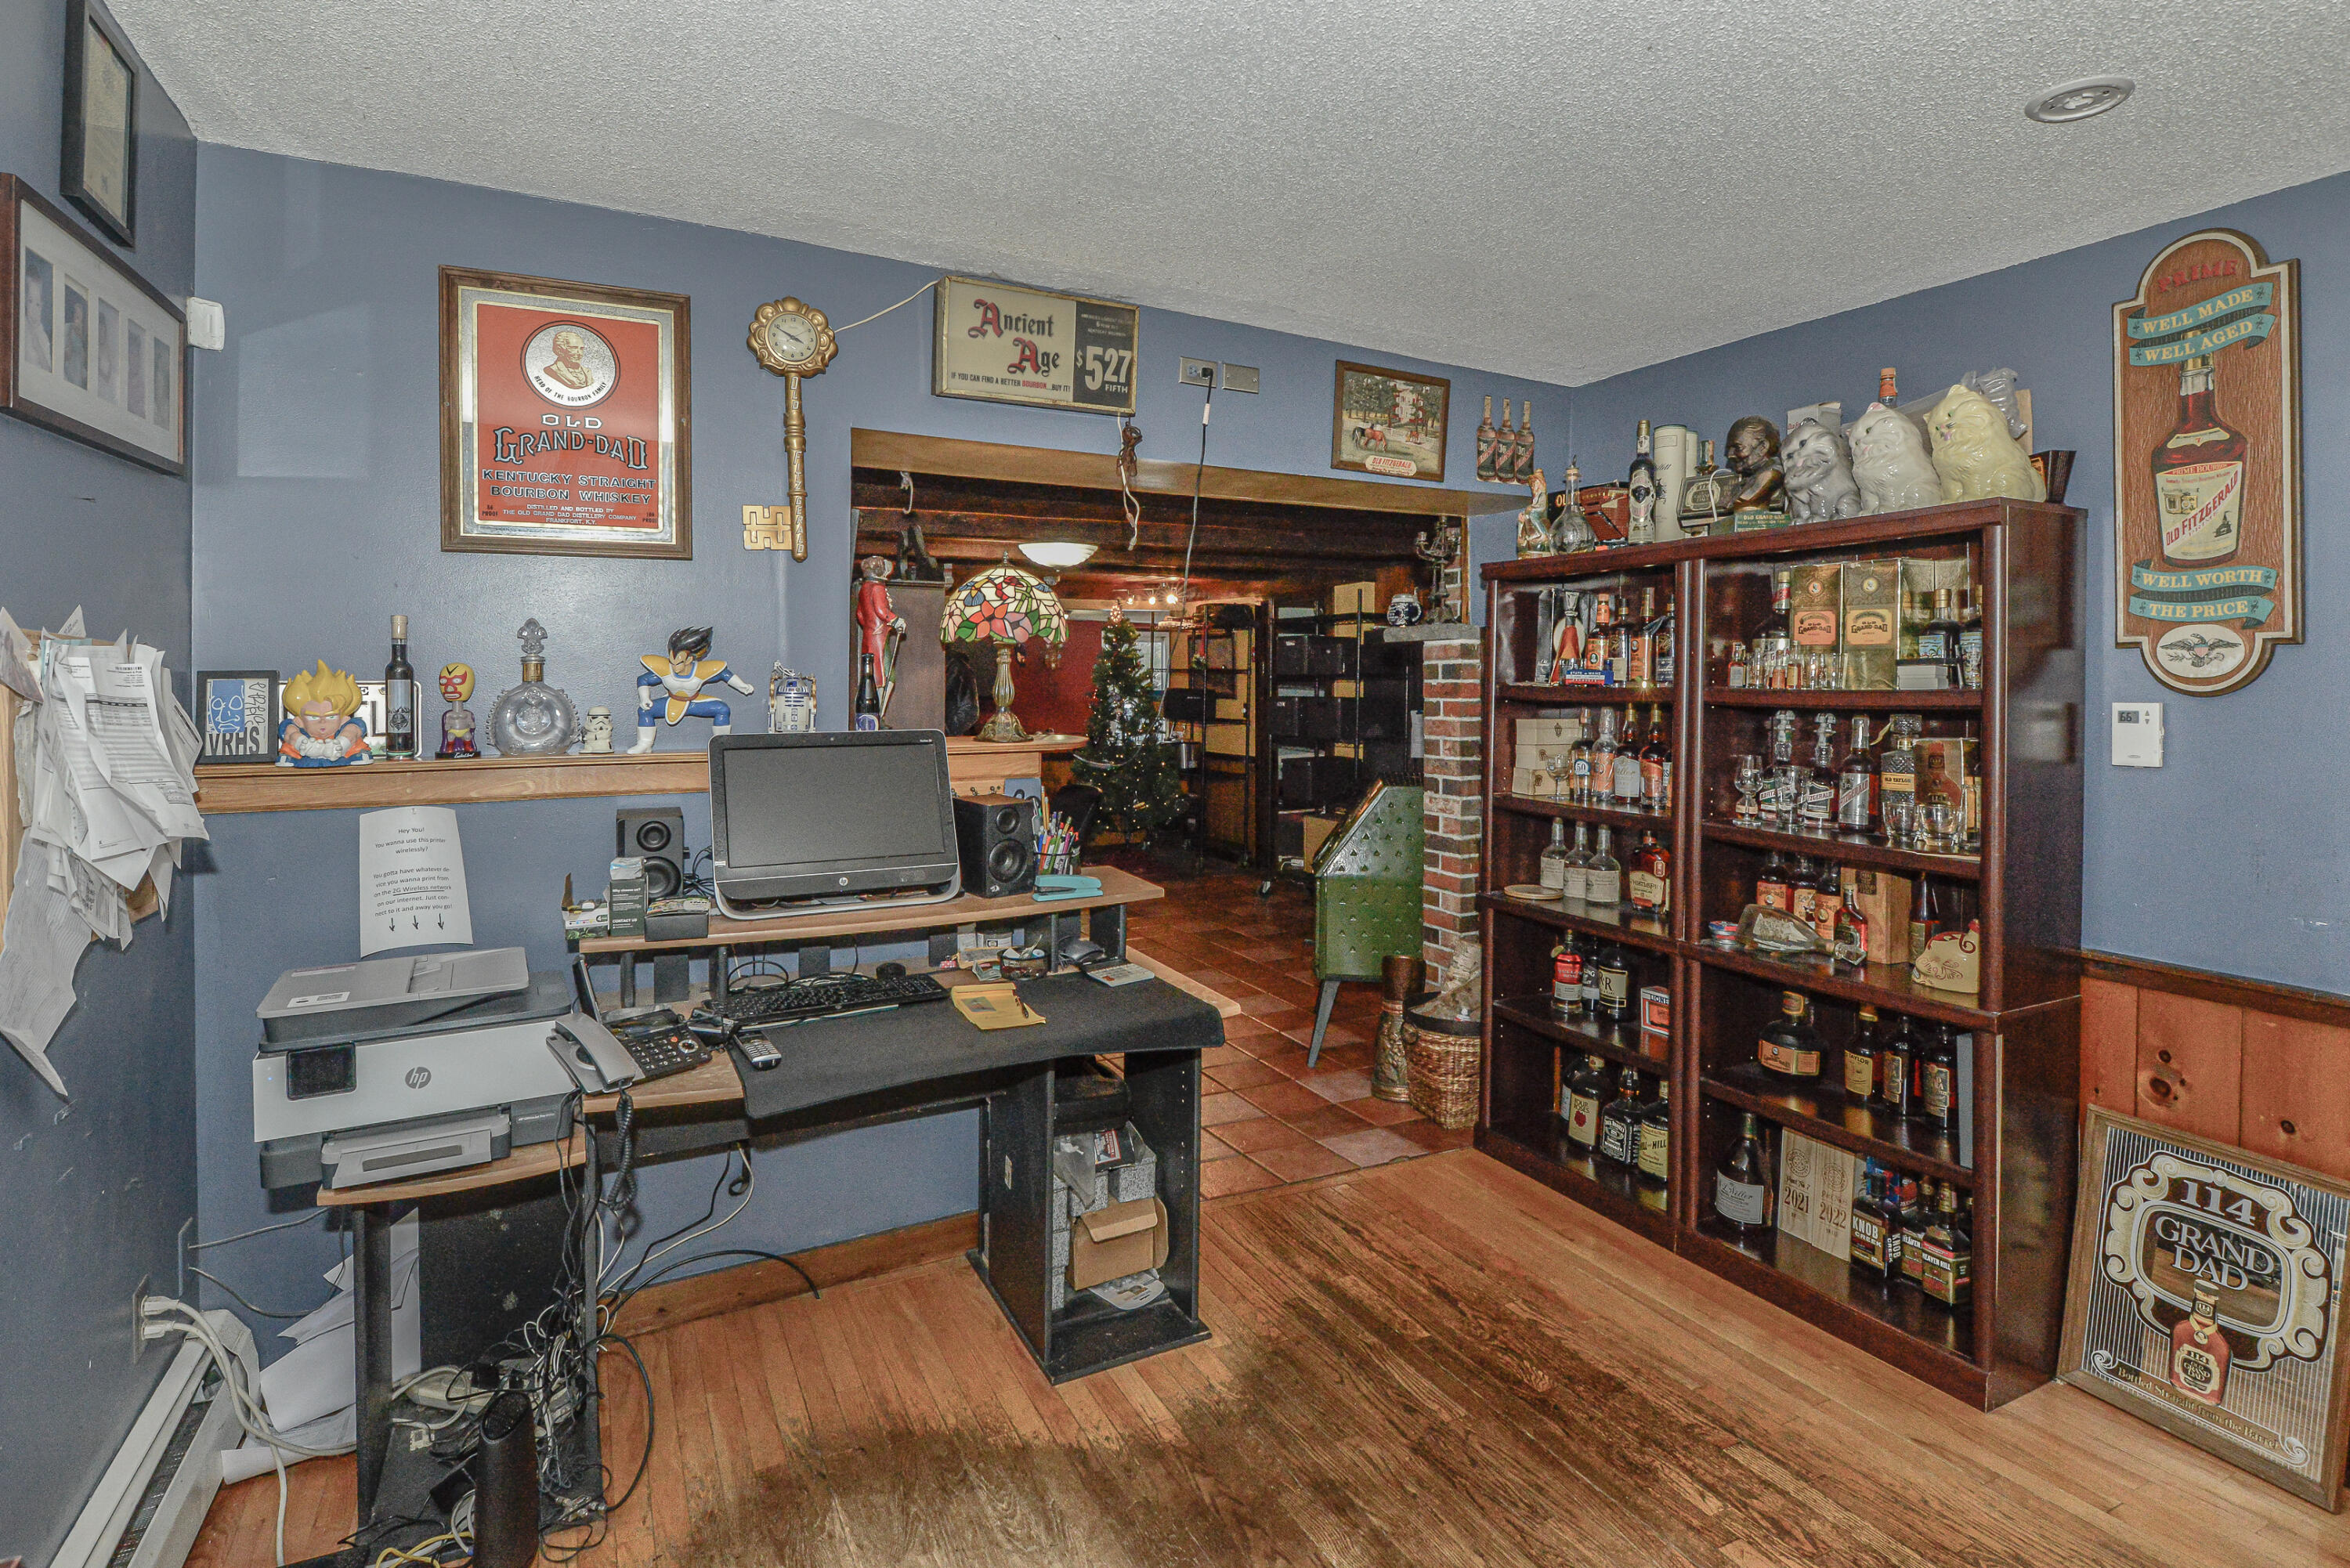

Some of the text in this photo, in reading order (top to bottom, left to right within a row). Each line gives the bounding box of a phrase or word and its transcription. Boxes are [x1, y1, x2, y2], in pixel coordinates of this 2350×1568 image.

[2157, 259, 2238, 293] PRIME
[967, 298, 1054, 338] Ancient
[2142, 289, 2253, 334] WELL MADE
[2145, 321, 2253, 363] WELL AGED
[1007, 338, 1060, 377] Age
[982, 375, 993, 384] FIND
[1104, 384, 1128, 393] FIFTH
[541, 414, 602, 429] OLD
[494, 427, 648, 470] GRAND-DAD
[483, 469, 656, 490] KENTUCKY STRAIGHT
[490, 486, 651, 504] BOURBON WHISKEY
[2166, 527, 2179, 546] OLD
[2182, 470, 2238, 535] FITZGERALD
[2142, 570, 2263, 588] WELL WORTH
[2149, 601, 2249, 618] THE PRICE
[208, 726, 260, 756] VRHS
[1576, 763, 1585, 771] 50
[396, 846, 428, 854] wirelessly?
[383, 869, 398, 879] gotta
[1651, 995, 1669, 1004] LIONE
[407, 1068, 429, 1086] hp
[1652, 1140, 1666, 1149] HILL
[1784, 1187, 1809, 1213] 2021
[2181, 1180, 2256, 1226] 114
[1819, 1201, 1846, 1229] 2022
[1853, 1216, 1878, 1240] KNOB
[1855, 1231, 1882, 1248] CREEK
[1892, 1233, 1901, 1259] KNOB
[1902, 1234, 1921, 1248] HEAVEN
[2155, 1216, 2274, 1275] GRAND
[1922, 1252, 1950, 1271] HEAVEN HILL
[2173, 1245, 2248, 1291] DAD
[2189, 1351, 2207, 1363] 114
[2118, 1367, 2279, 1450] Bottled Straight from the Barrel
